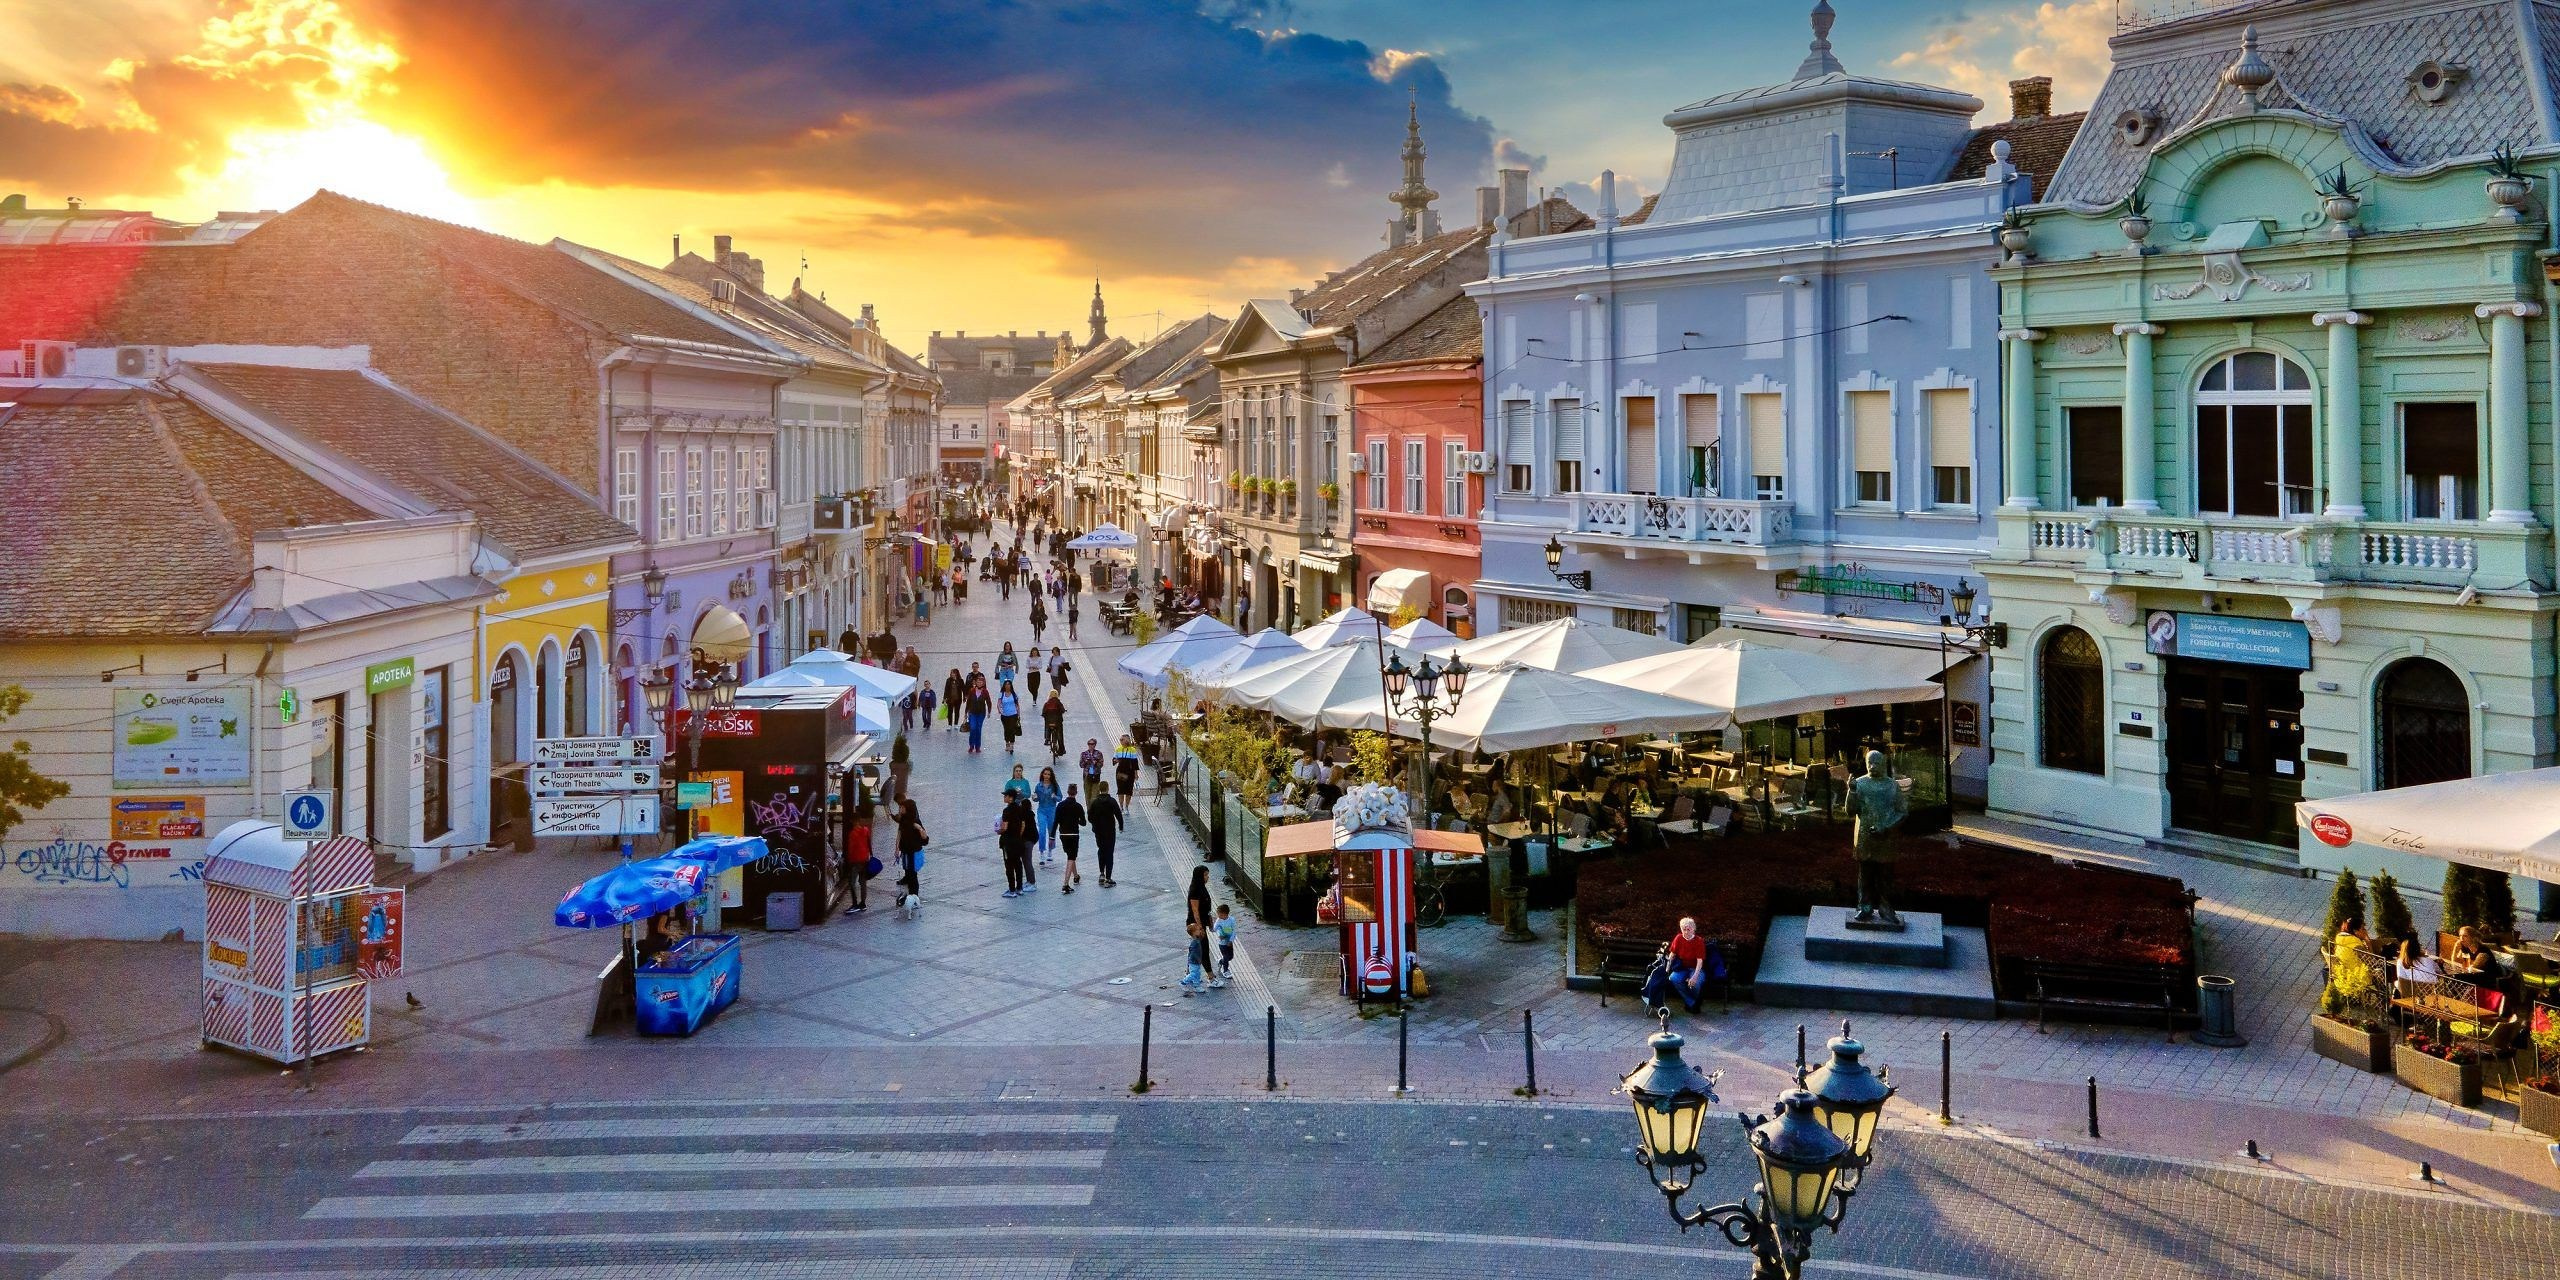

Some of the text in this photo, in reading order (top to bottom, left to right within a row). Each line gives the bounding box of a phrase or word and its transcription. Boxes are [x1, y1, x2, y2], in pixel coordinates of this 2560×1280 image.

[2190, 623, 2217, 632] ЗБИРКА
[2219, 626, 2246, 635] СТРАНЕ
[2247, 628, 2292, 638] УМЕТНОСТИ
[2190, 639, 2280, 654] FOREIGN ART COLLECTION
[373, 665, 412, 686] APOTEKA
[188, 696, 225, 705] Apoteka
[551, 742, 568, 751] Змај
[598, 741, 621, 750] улица
[414, 752, 421, 764] 20
[551, 751, 569, 759] Zmaj
[570, 750, 595, 758] Jovina
[551, 772, 623, 780] Позориште младих
[551, 780, 572, 788] Youth
[551, 803, 595, 811] Туристички
[551, 811, 601, 821] инфо-центар
[552, 823, 600, 832] Tourist Office
[2382, 826, 2426, 850] Tesla
[2457, 848, 2494, 860] CZECH
